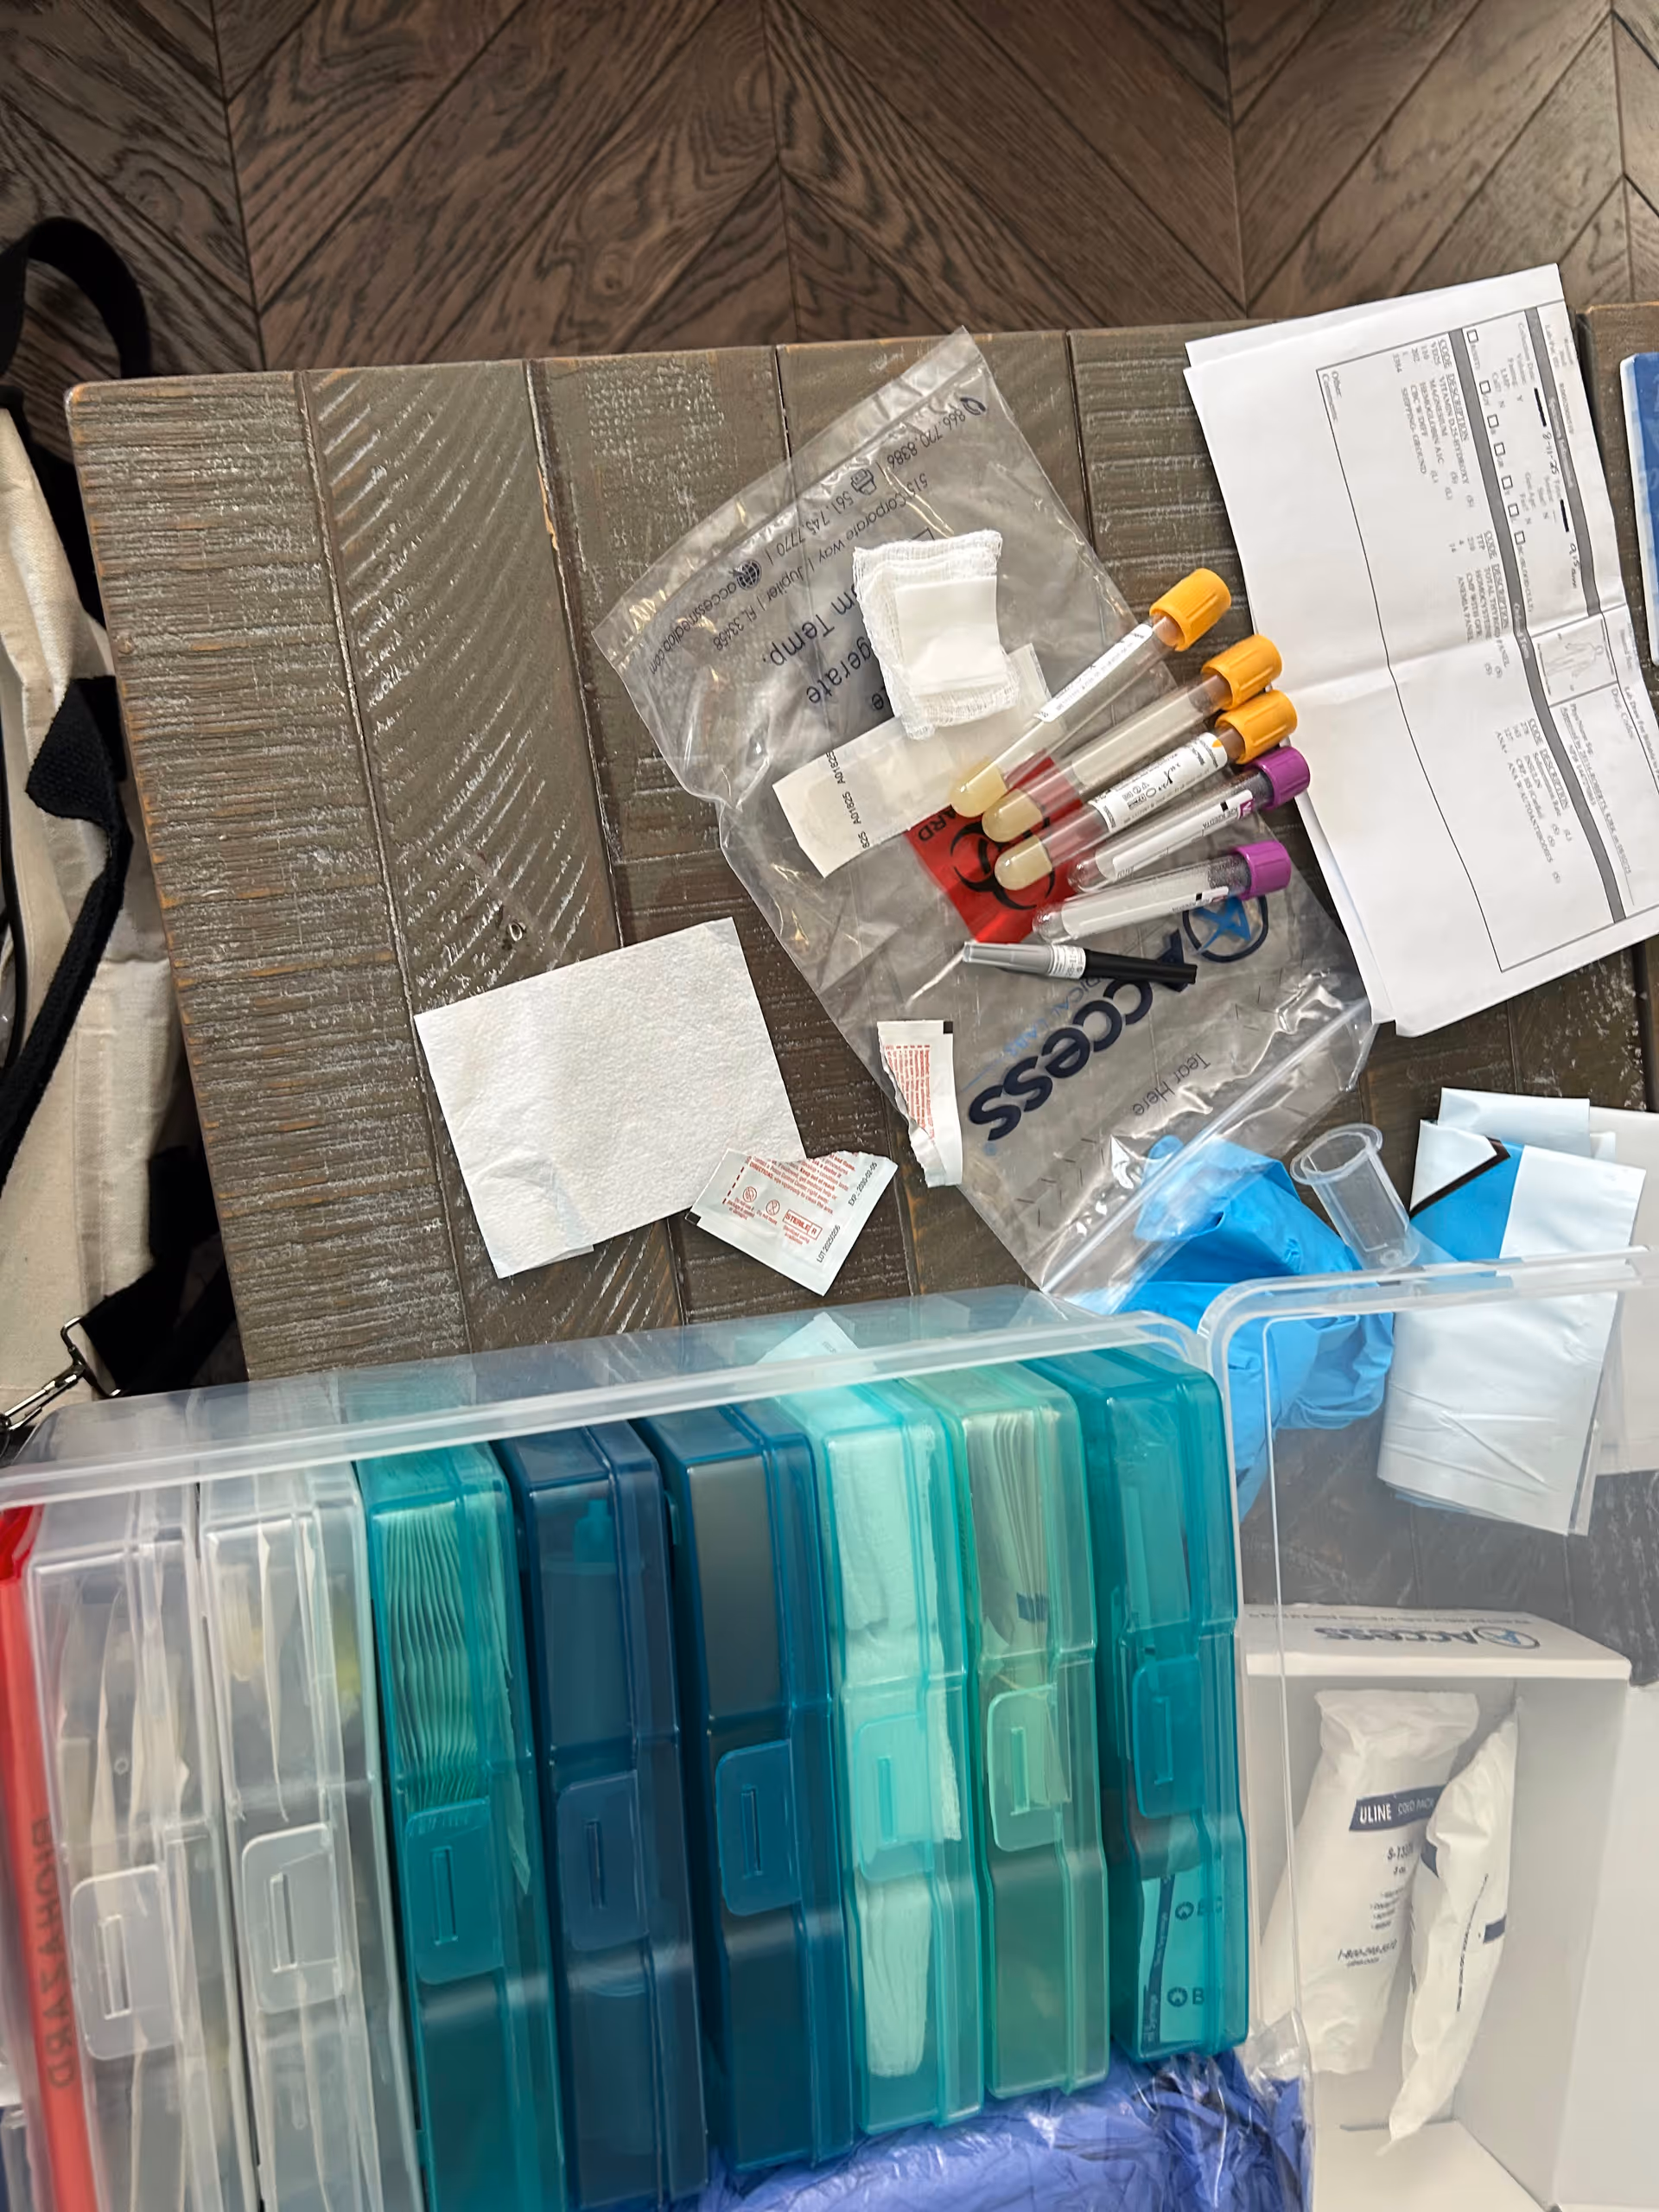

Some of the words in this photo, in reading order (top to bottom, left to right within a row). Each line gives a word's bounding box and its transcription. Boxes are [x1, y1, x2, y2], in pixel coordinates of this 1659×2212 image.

[1418, 381, 1440, 444] HEMOGLOBIN
[1427, 378, 1449, 436] MAGNESIUM
[1446, 372, 1470, 443] DESCRIPTION
[772, 488, 855, 558] 561.745.7770
[841, 490, 908, 543] Corporate
[813, 537, 846, 564] Way
[761, 563, 806, 604] Jupiter
[757, 608, 836, 672] Temp.
[842, 791, 861, 823] A01825
[1172, 1048, 1211, 1084] Tear
[1129, 1079, 1175, 1119] Here
[784, 1212, 811, 1231] STERILE
[1358, 1802, 1392, 1824] ULINE
